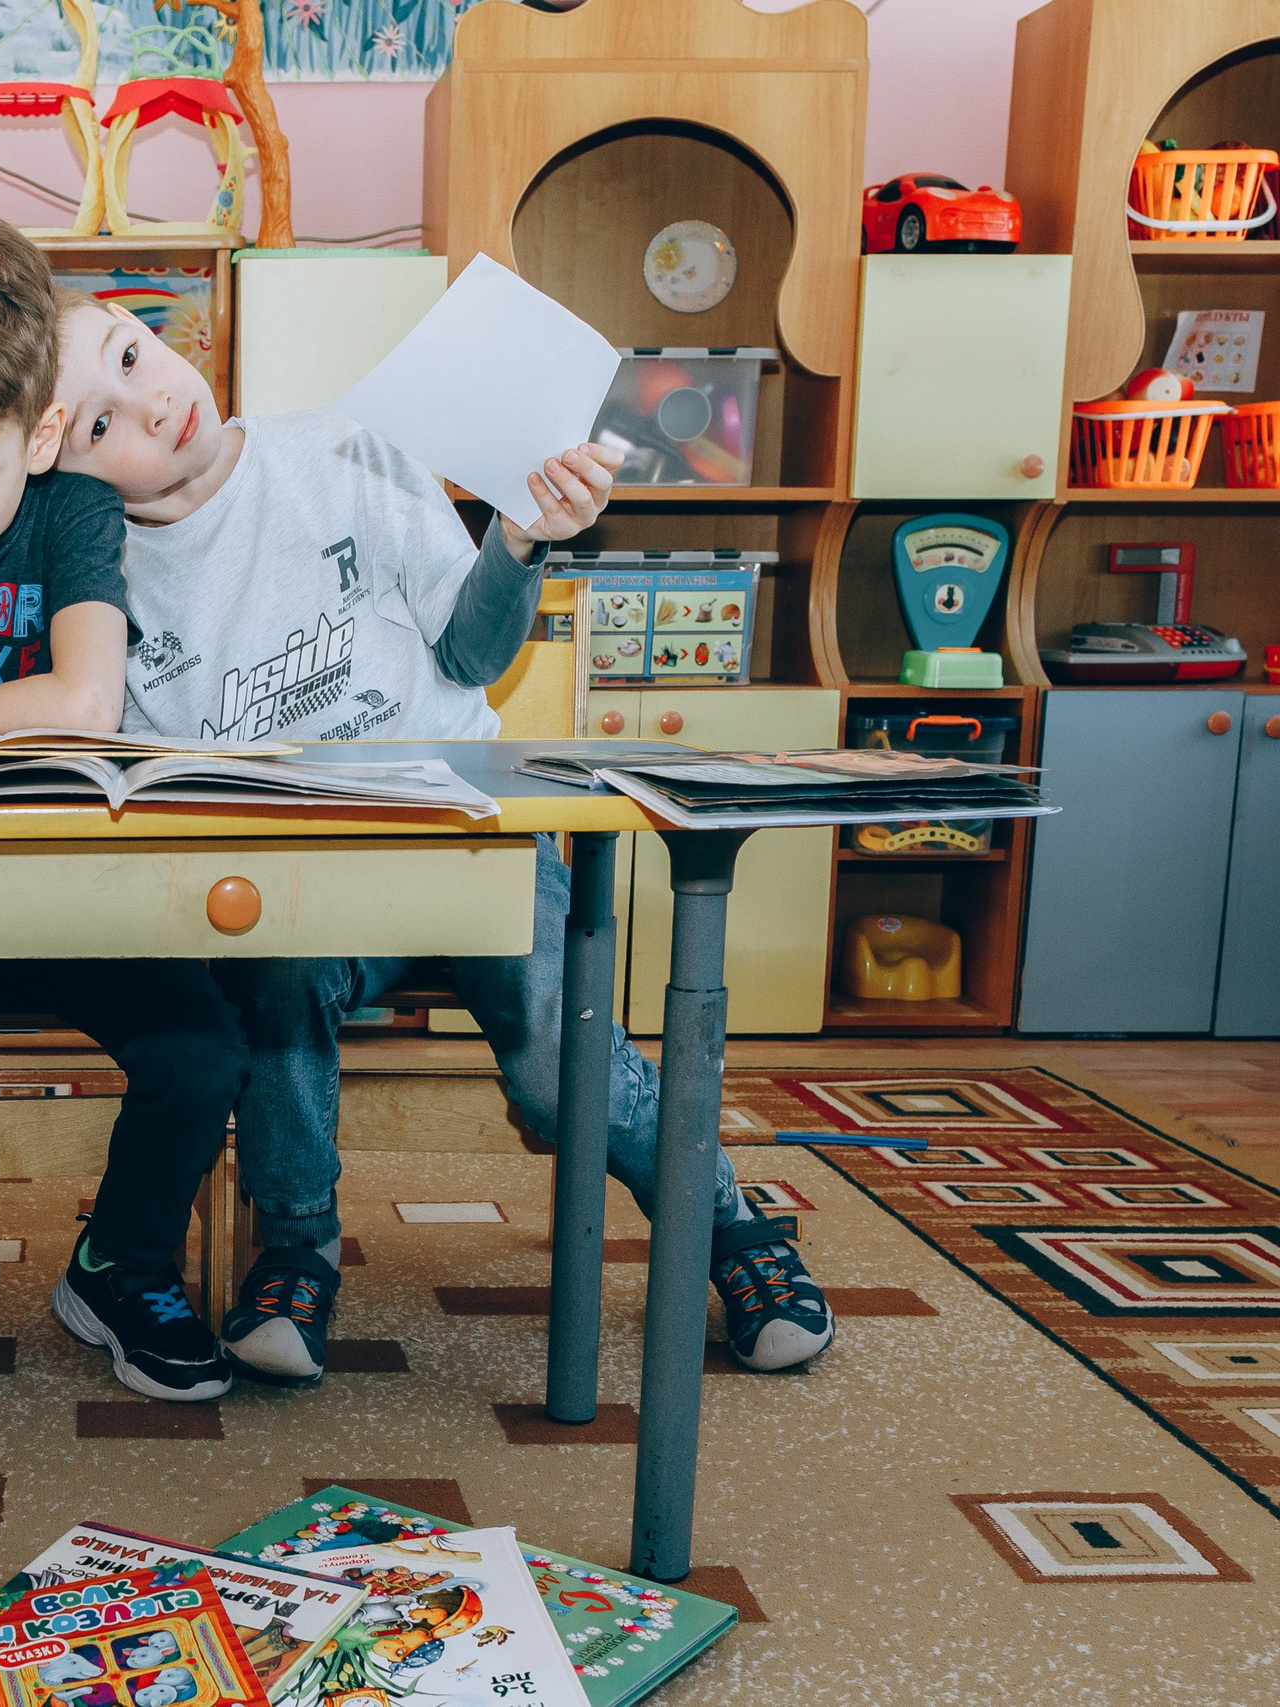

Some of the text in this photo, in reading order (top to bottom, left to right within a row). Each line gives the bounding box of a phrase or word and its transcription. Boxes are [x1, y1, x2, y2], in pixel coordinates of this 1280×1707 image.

[658, 575, 718, 586] ПИТАНИЯ
[142, 654, 203, 693] MOTOCROSS
[320, 710, 369, 741] BURN UP
[338, 702, 402, 741] THE STREET
[7, 1643, 62, 1665] СКАЗКА
[571, 1632, 614, 1658] СКАЗКИ
[580, 1628, 631, 1668] ЛЮБИМЫЕ
